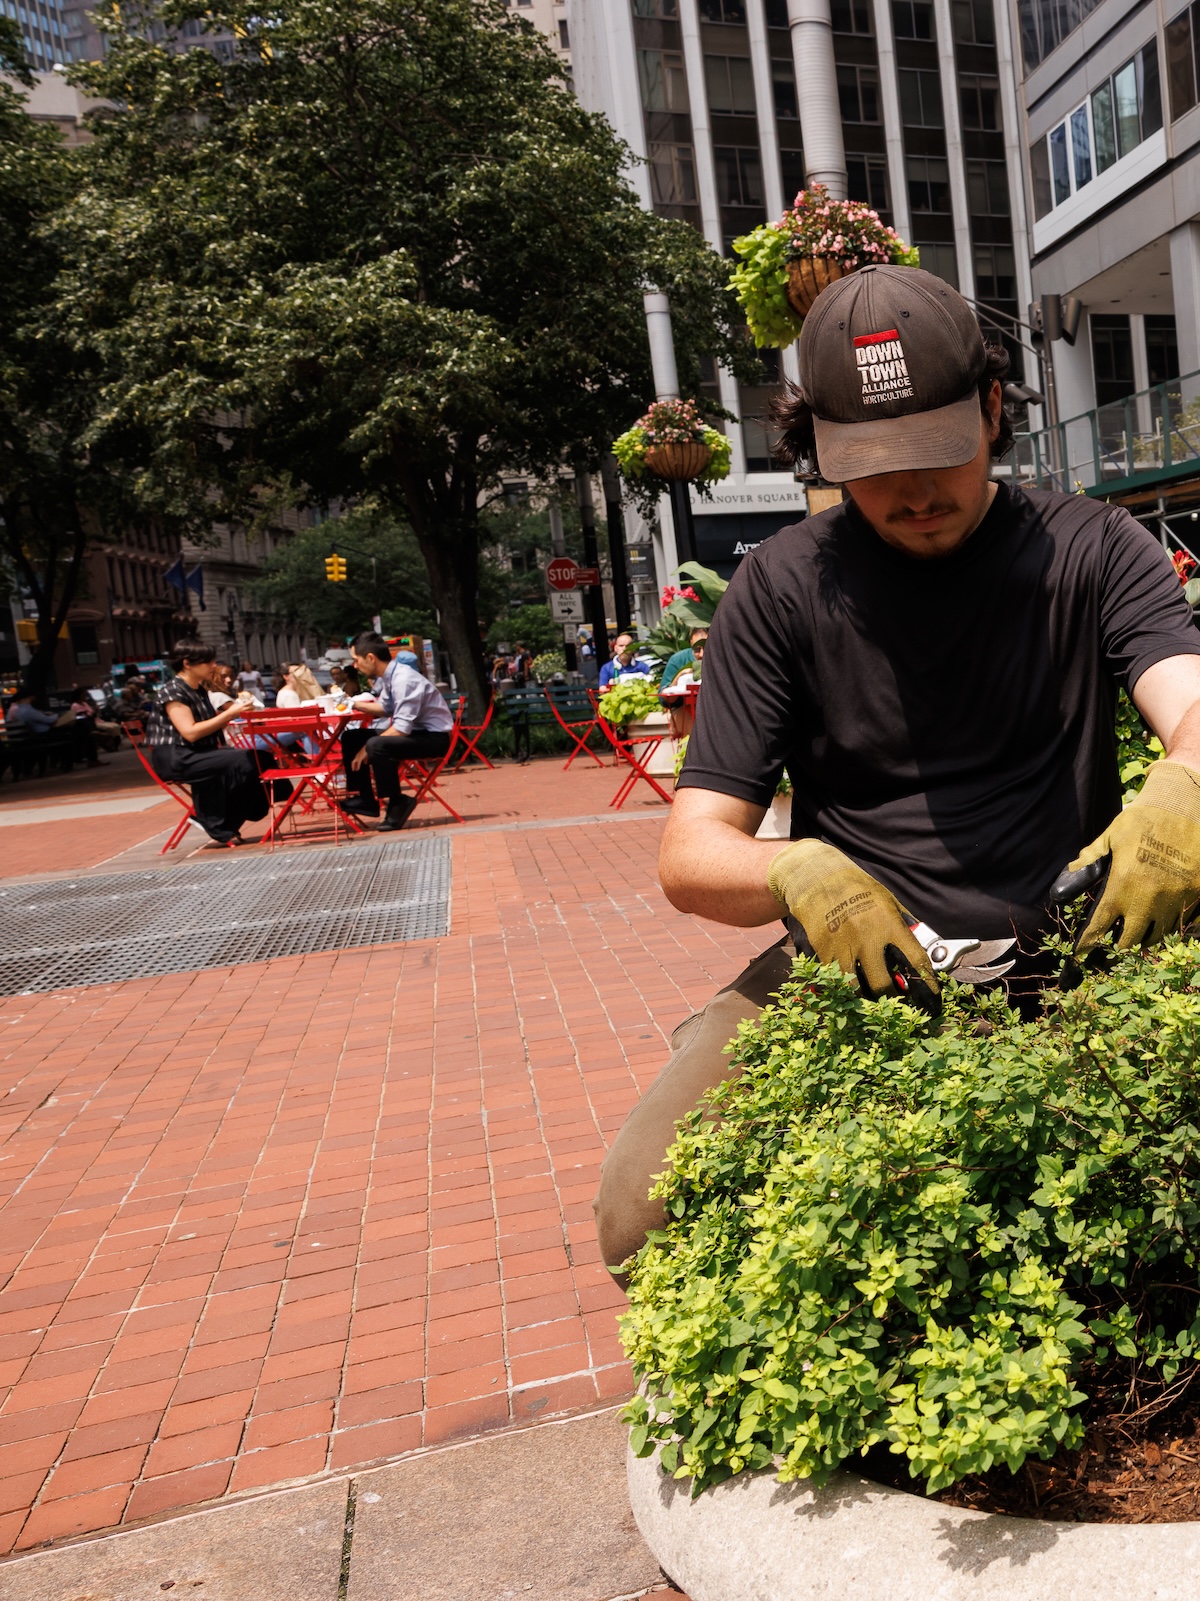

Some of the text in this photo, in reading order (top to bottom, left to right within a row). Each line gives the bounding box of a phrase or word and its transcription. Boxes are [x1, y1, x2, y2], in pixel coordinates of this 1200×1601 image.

[855, 340, 905, 366] DOWN
[857, 358, 909, 384] TOWN
[861, 376, 912, 395] ALLIANCE
[862, 387, 915, 405] HORTICULTURE
[701, 494, 746, 505] HANOVER
[757, 492, 800, 504] SQUARE
[1140, 834, 1165, 853] FIRM
[1165, 845, 1191, 864] GRIP
[825, 900, 849, 922] FIRM
[848, 891, 872, 905] GRIP
